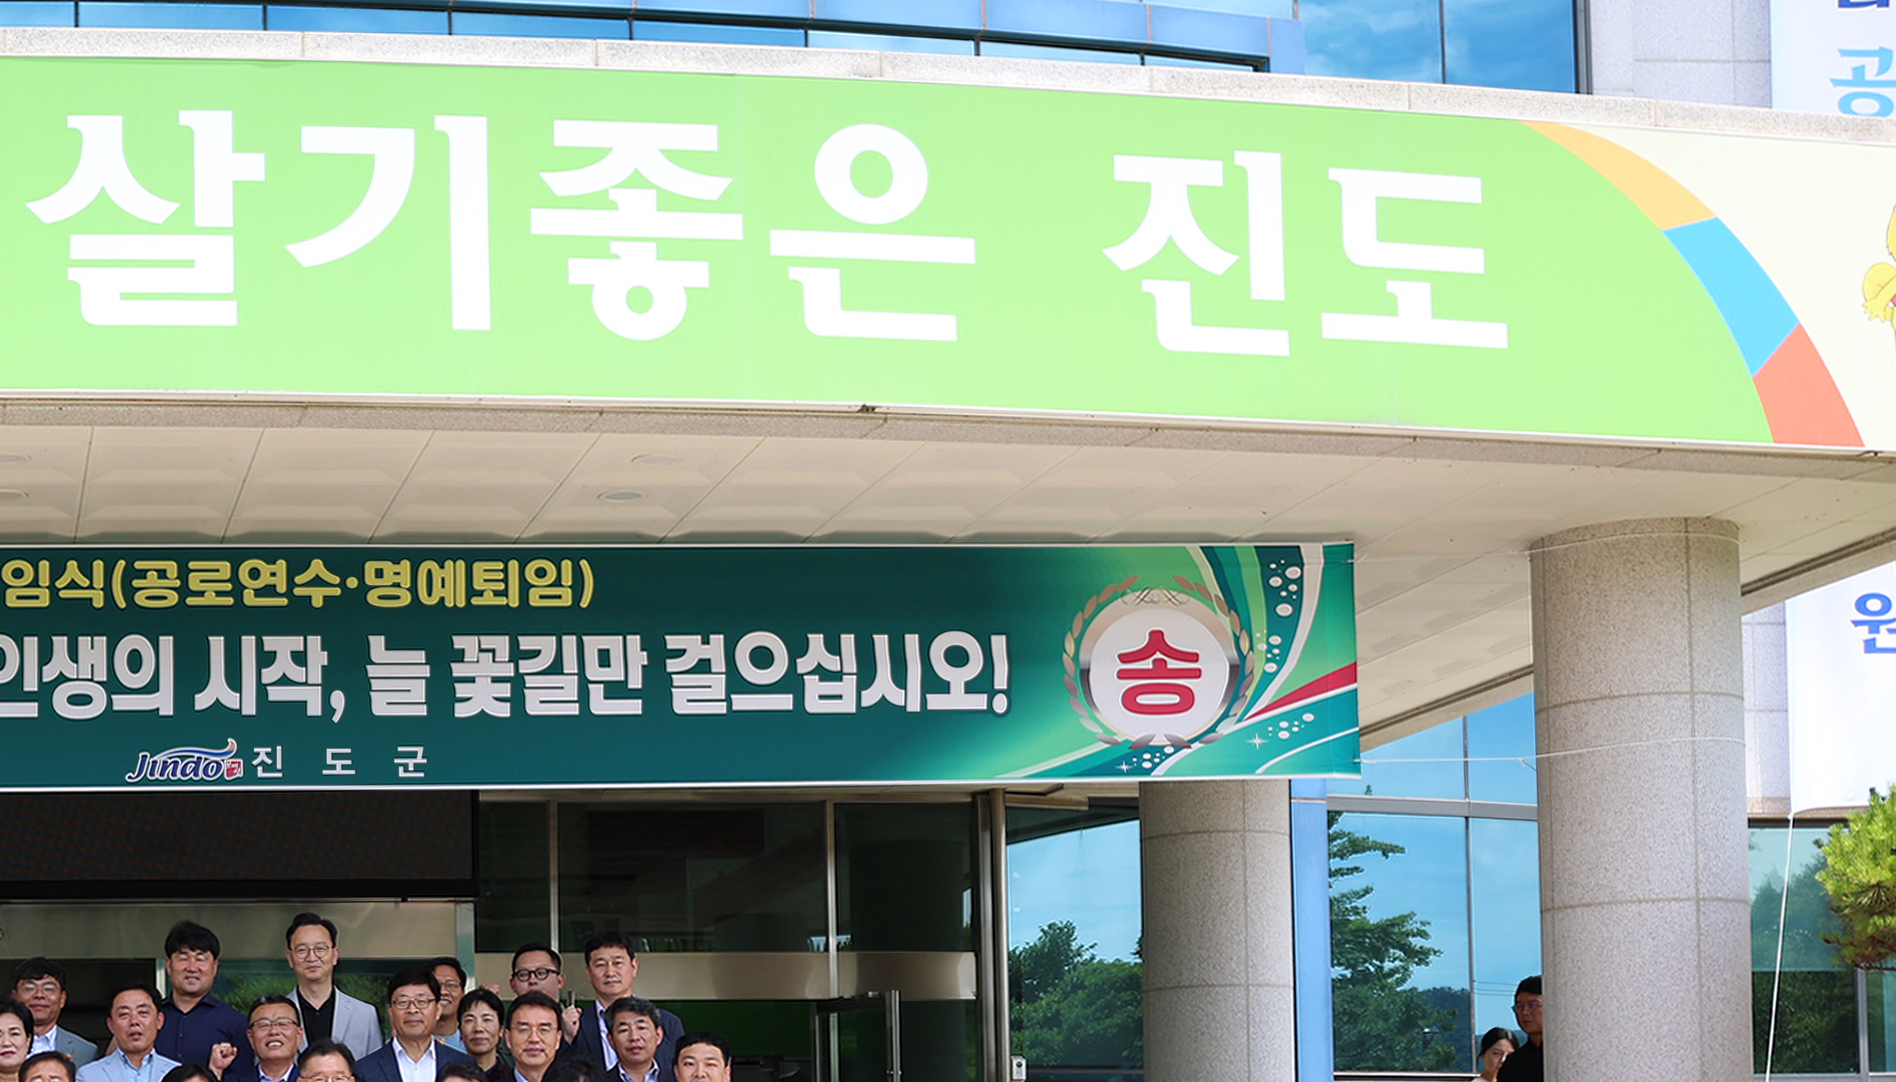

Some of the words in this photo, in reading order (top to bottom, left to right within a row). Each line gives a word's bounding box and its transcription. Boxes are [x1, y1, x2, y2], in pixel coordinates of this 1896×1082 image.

[25, 110, 976, 341] 살기좋은
[1102, 151, 1508, 356] 진도
[195, 636, 345, 723] 시작,
[366, 636, 430, 715] 늘
[451, 635, 647, 717] 꽃길만
[665, 631, 1008, 714] 걸으십시오!
[1116, 628, 1203, 716] 송
[125, 751, 224, 782] Jindo
